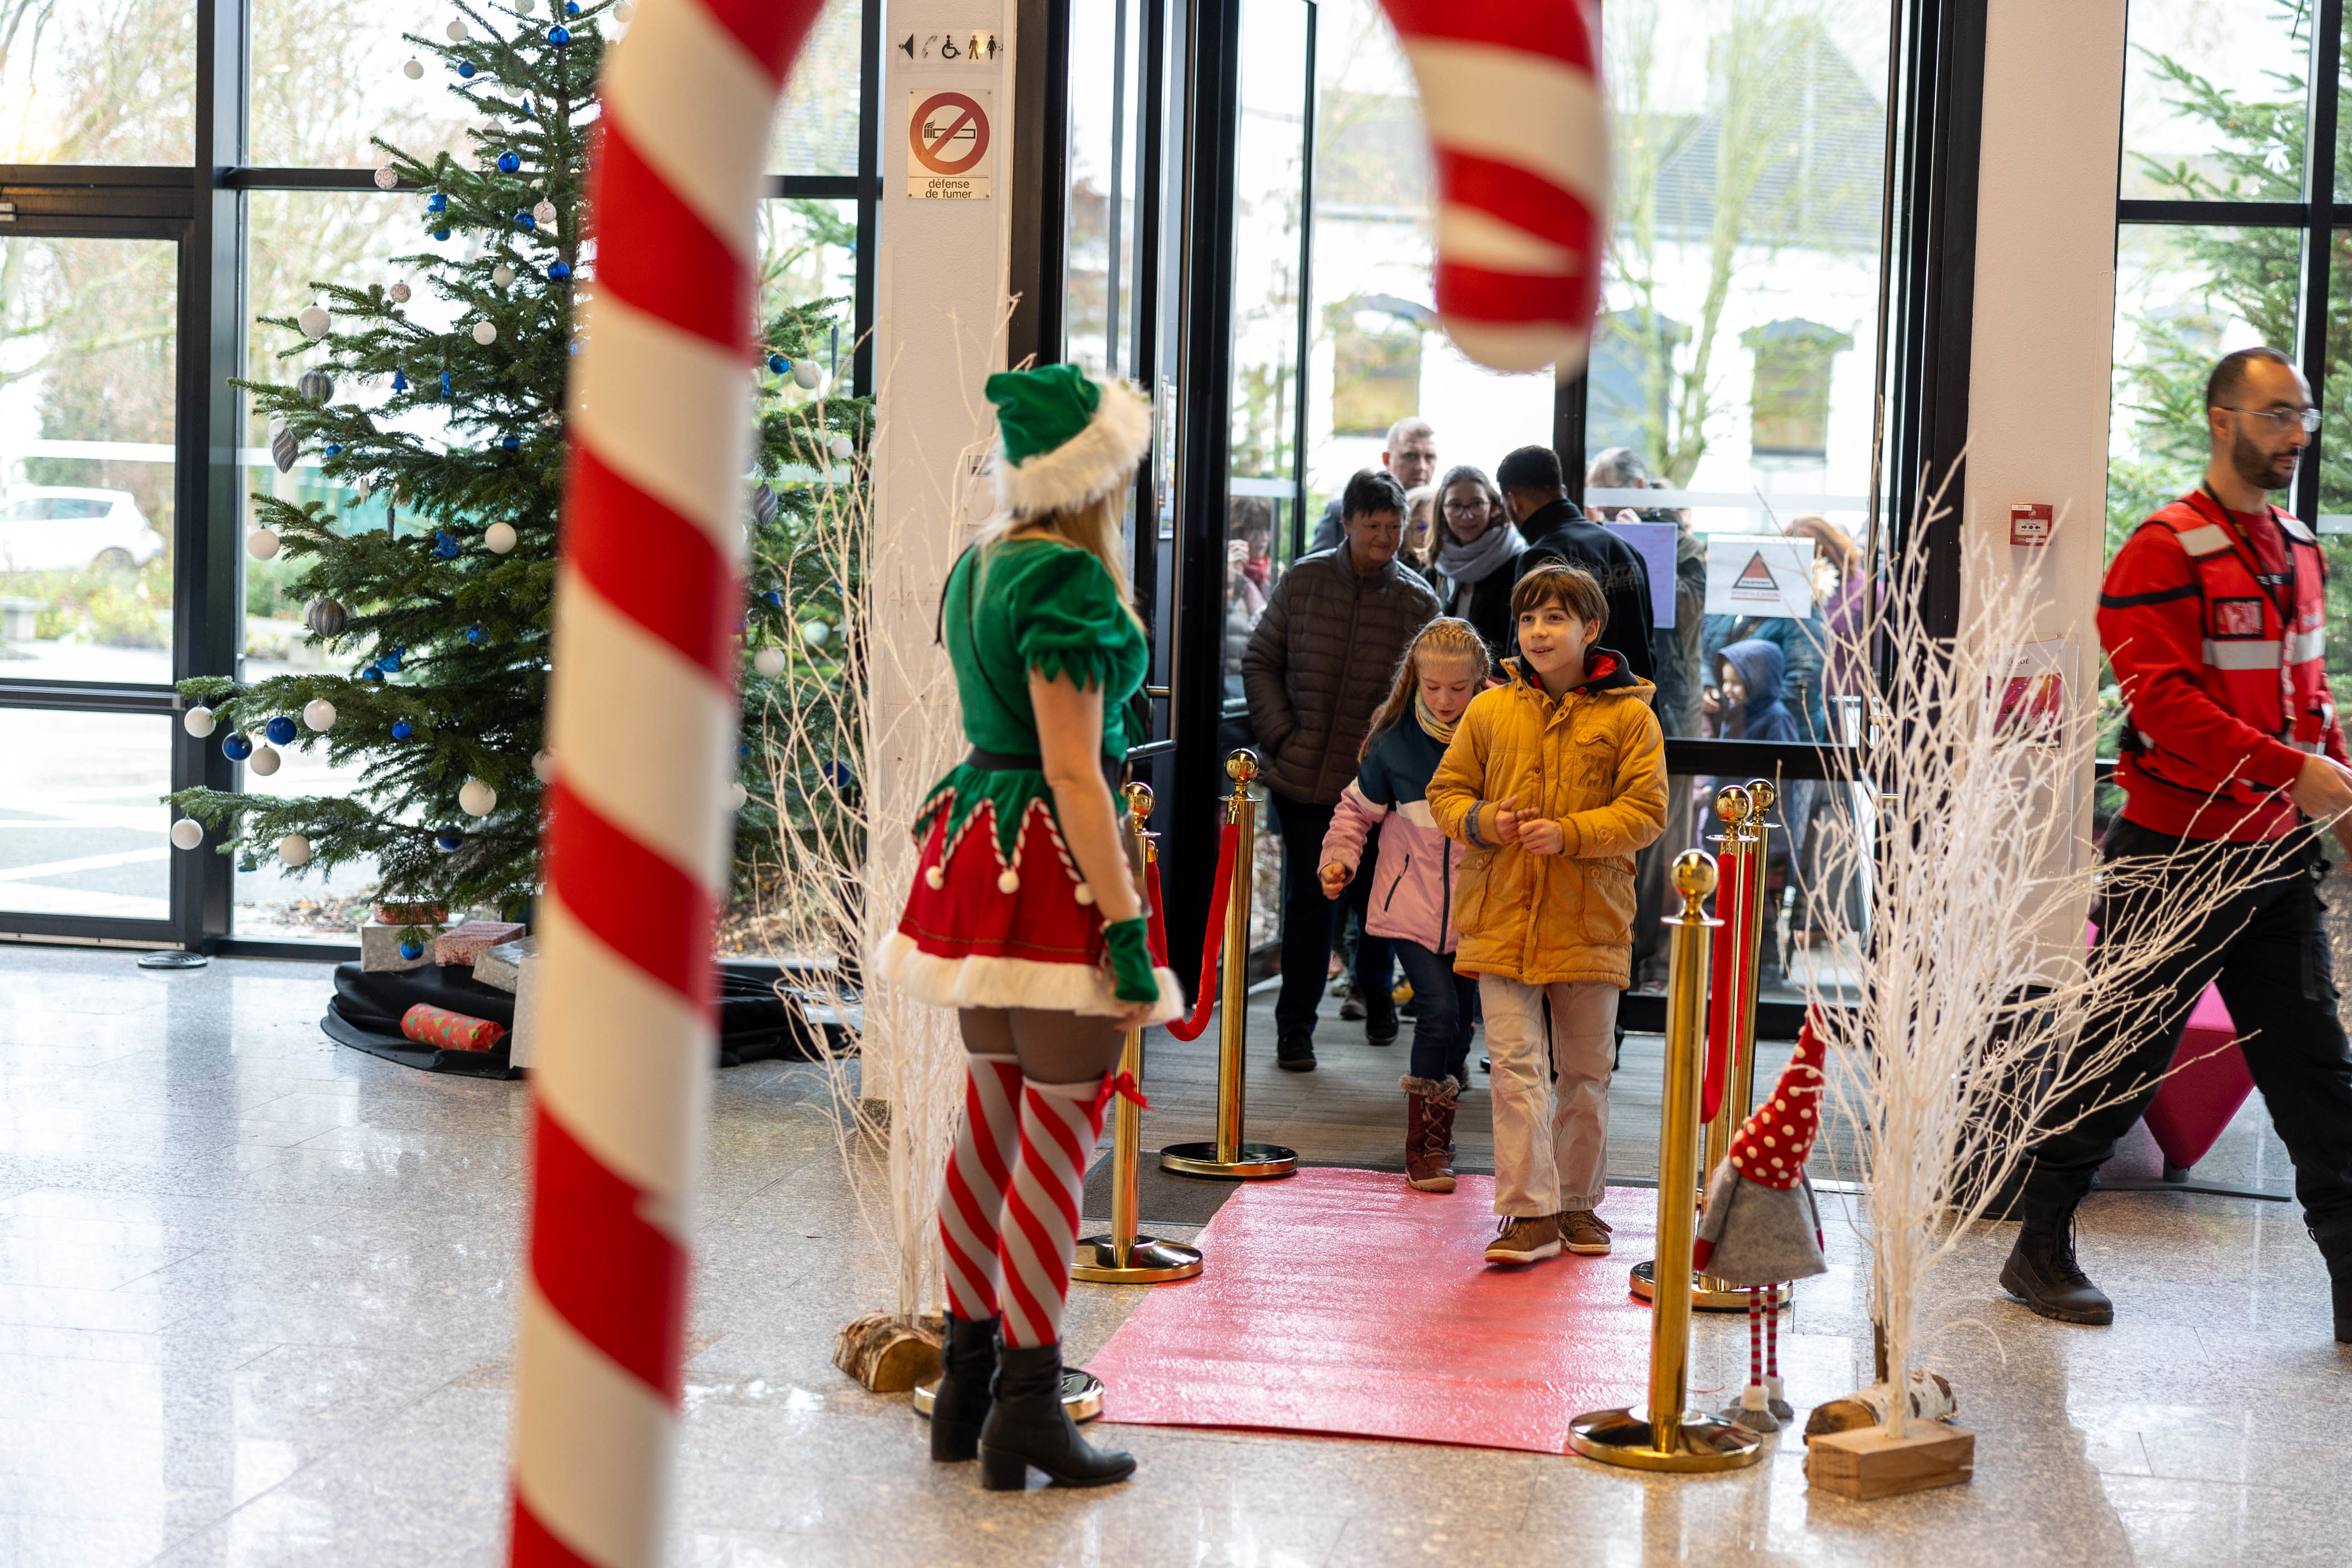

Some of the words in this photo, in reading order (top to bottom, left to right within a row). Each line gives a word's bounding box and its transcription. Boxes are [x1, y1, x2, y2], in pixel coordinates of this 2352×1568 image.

[929, 179, 969, 188] défense
[926, 189, 938, 198] de
[942, 189, 972, 198] fumer
